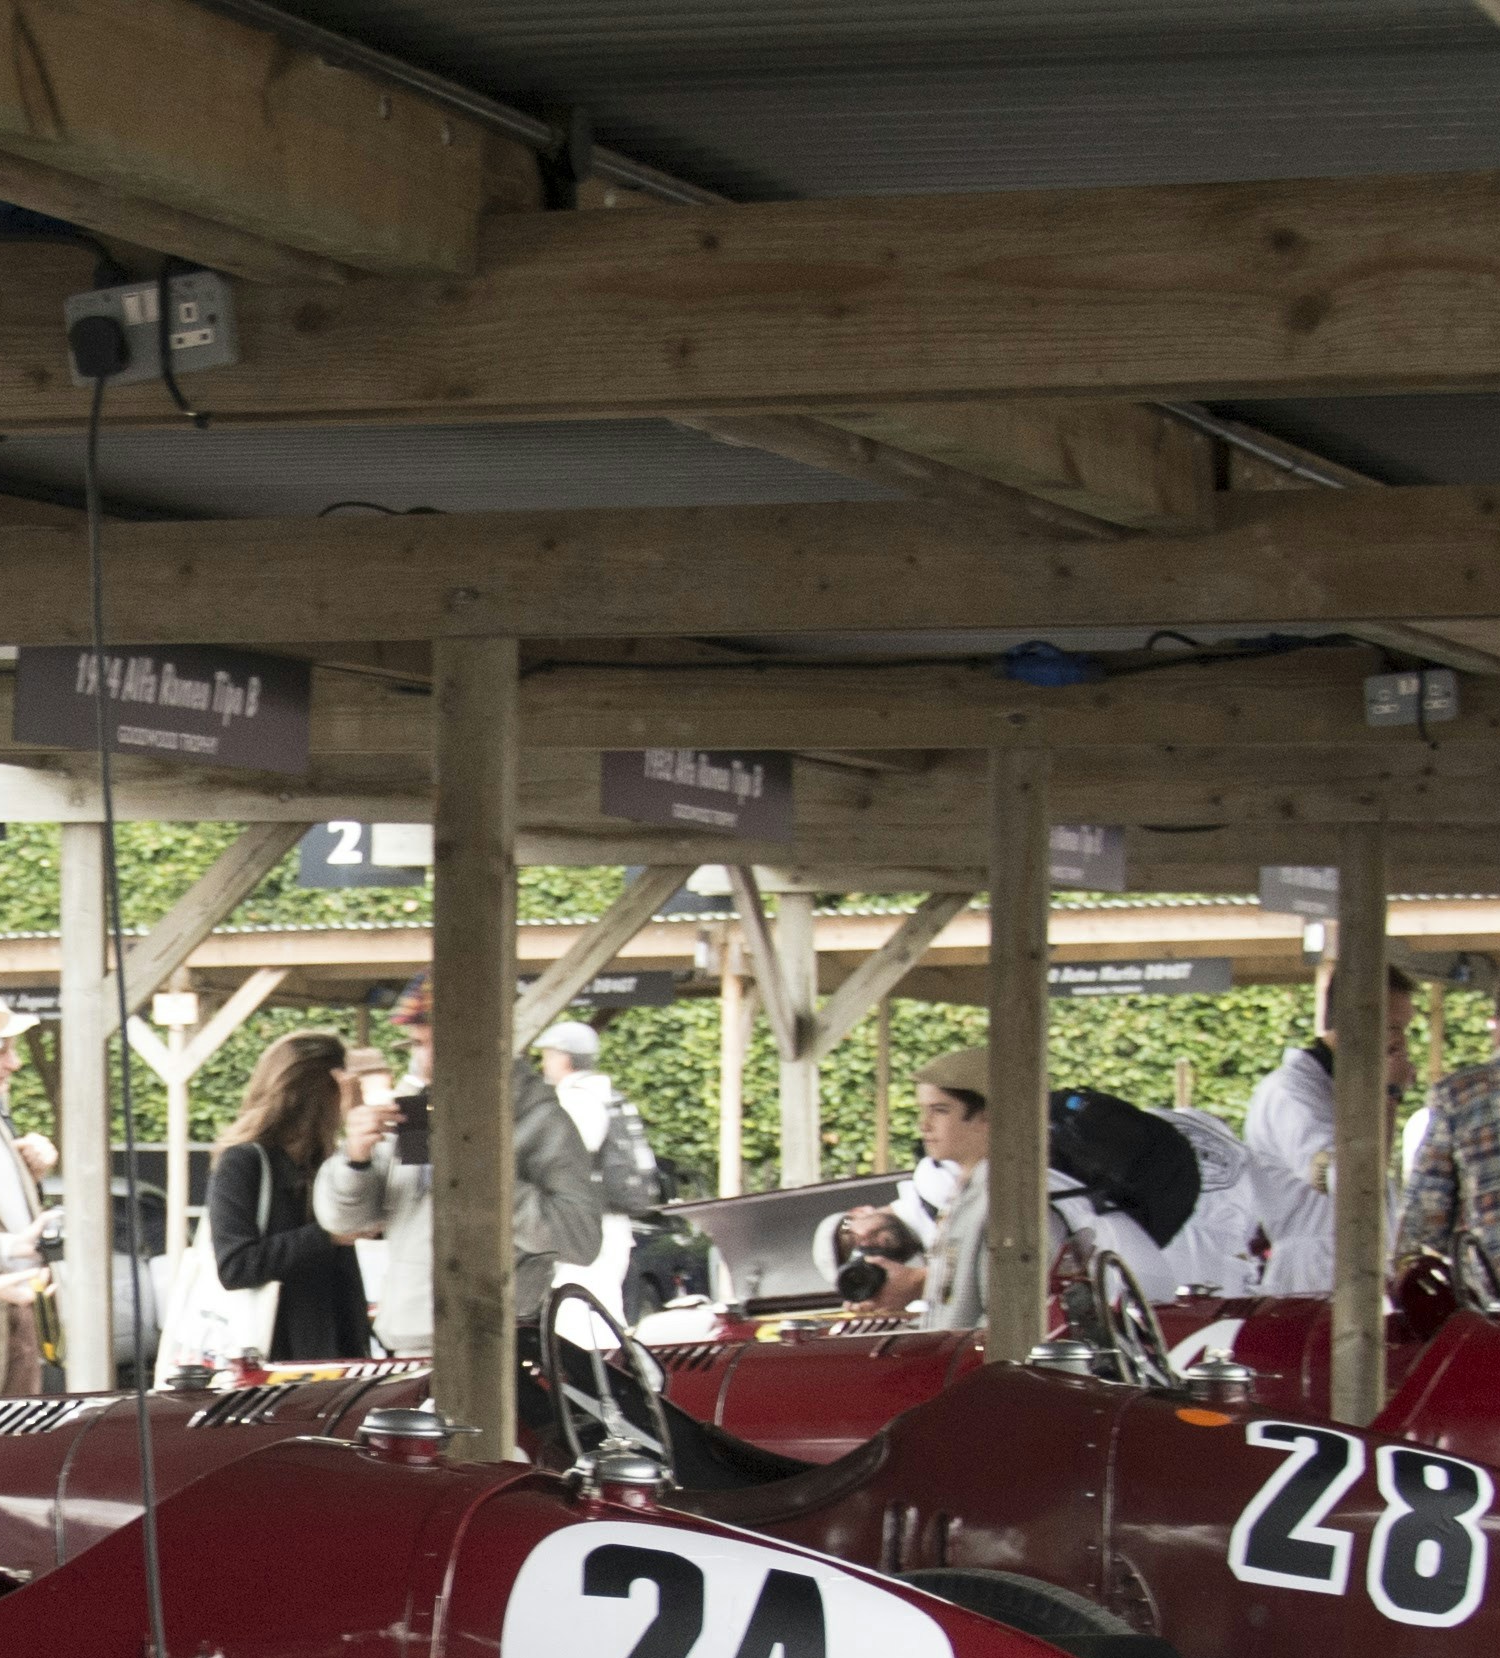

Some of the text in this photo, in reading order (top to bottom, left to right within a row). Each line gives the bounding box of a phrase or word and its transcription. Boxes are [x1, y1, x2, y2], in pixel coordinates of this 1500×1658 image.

[120, 655, 158, 705] Alfa
[158, 661, 212, 712] Romeo
[212, 669, 245, 727] Tipo
[325, 819, 364, 866] 2
[1228, 1420, 1494, 1628] 28
